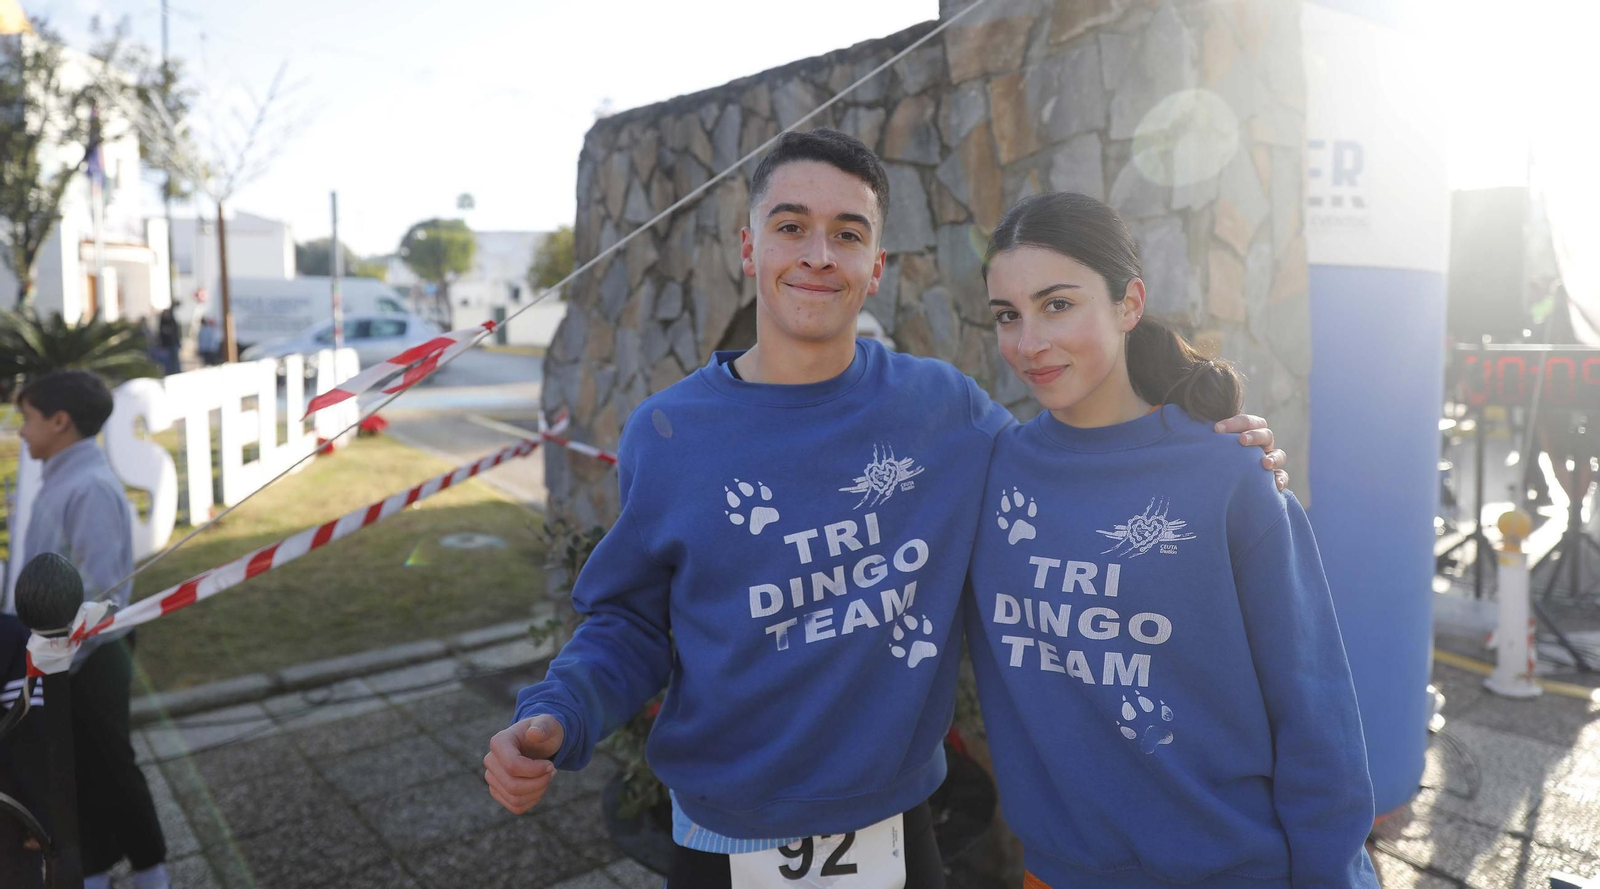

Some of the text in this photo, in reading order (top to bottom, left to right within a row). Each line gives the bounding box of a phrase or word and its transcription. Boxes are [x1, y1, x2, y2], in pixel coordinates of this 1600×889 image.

[784, 512, 880, 563] TRI
[749, 538, 929, 619] DINGO
[1029, 556, 1121, 597] TRI
[765, 581, 917, 651] TEAM
[993, 593, 1172, 645] DINGO
[1001, 635, 1151, 687] TEAM
[778, 831, 858, 880] 92
